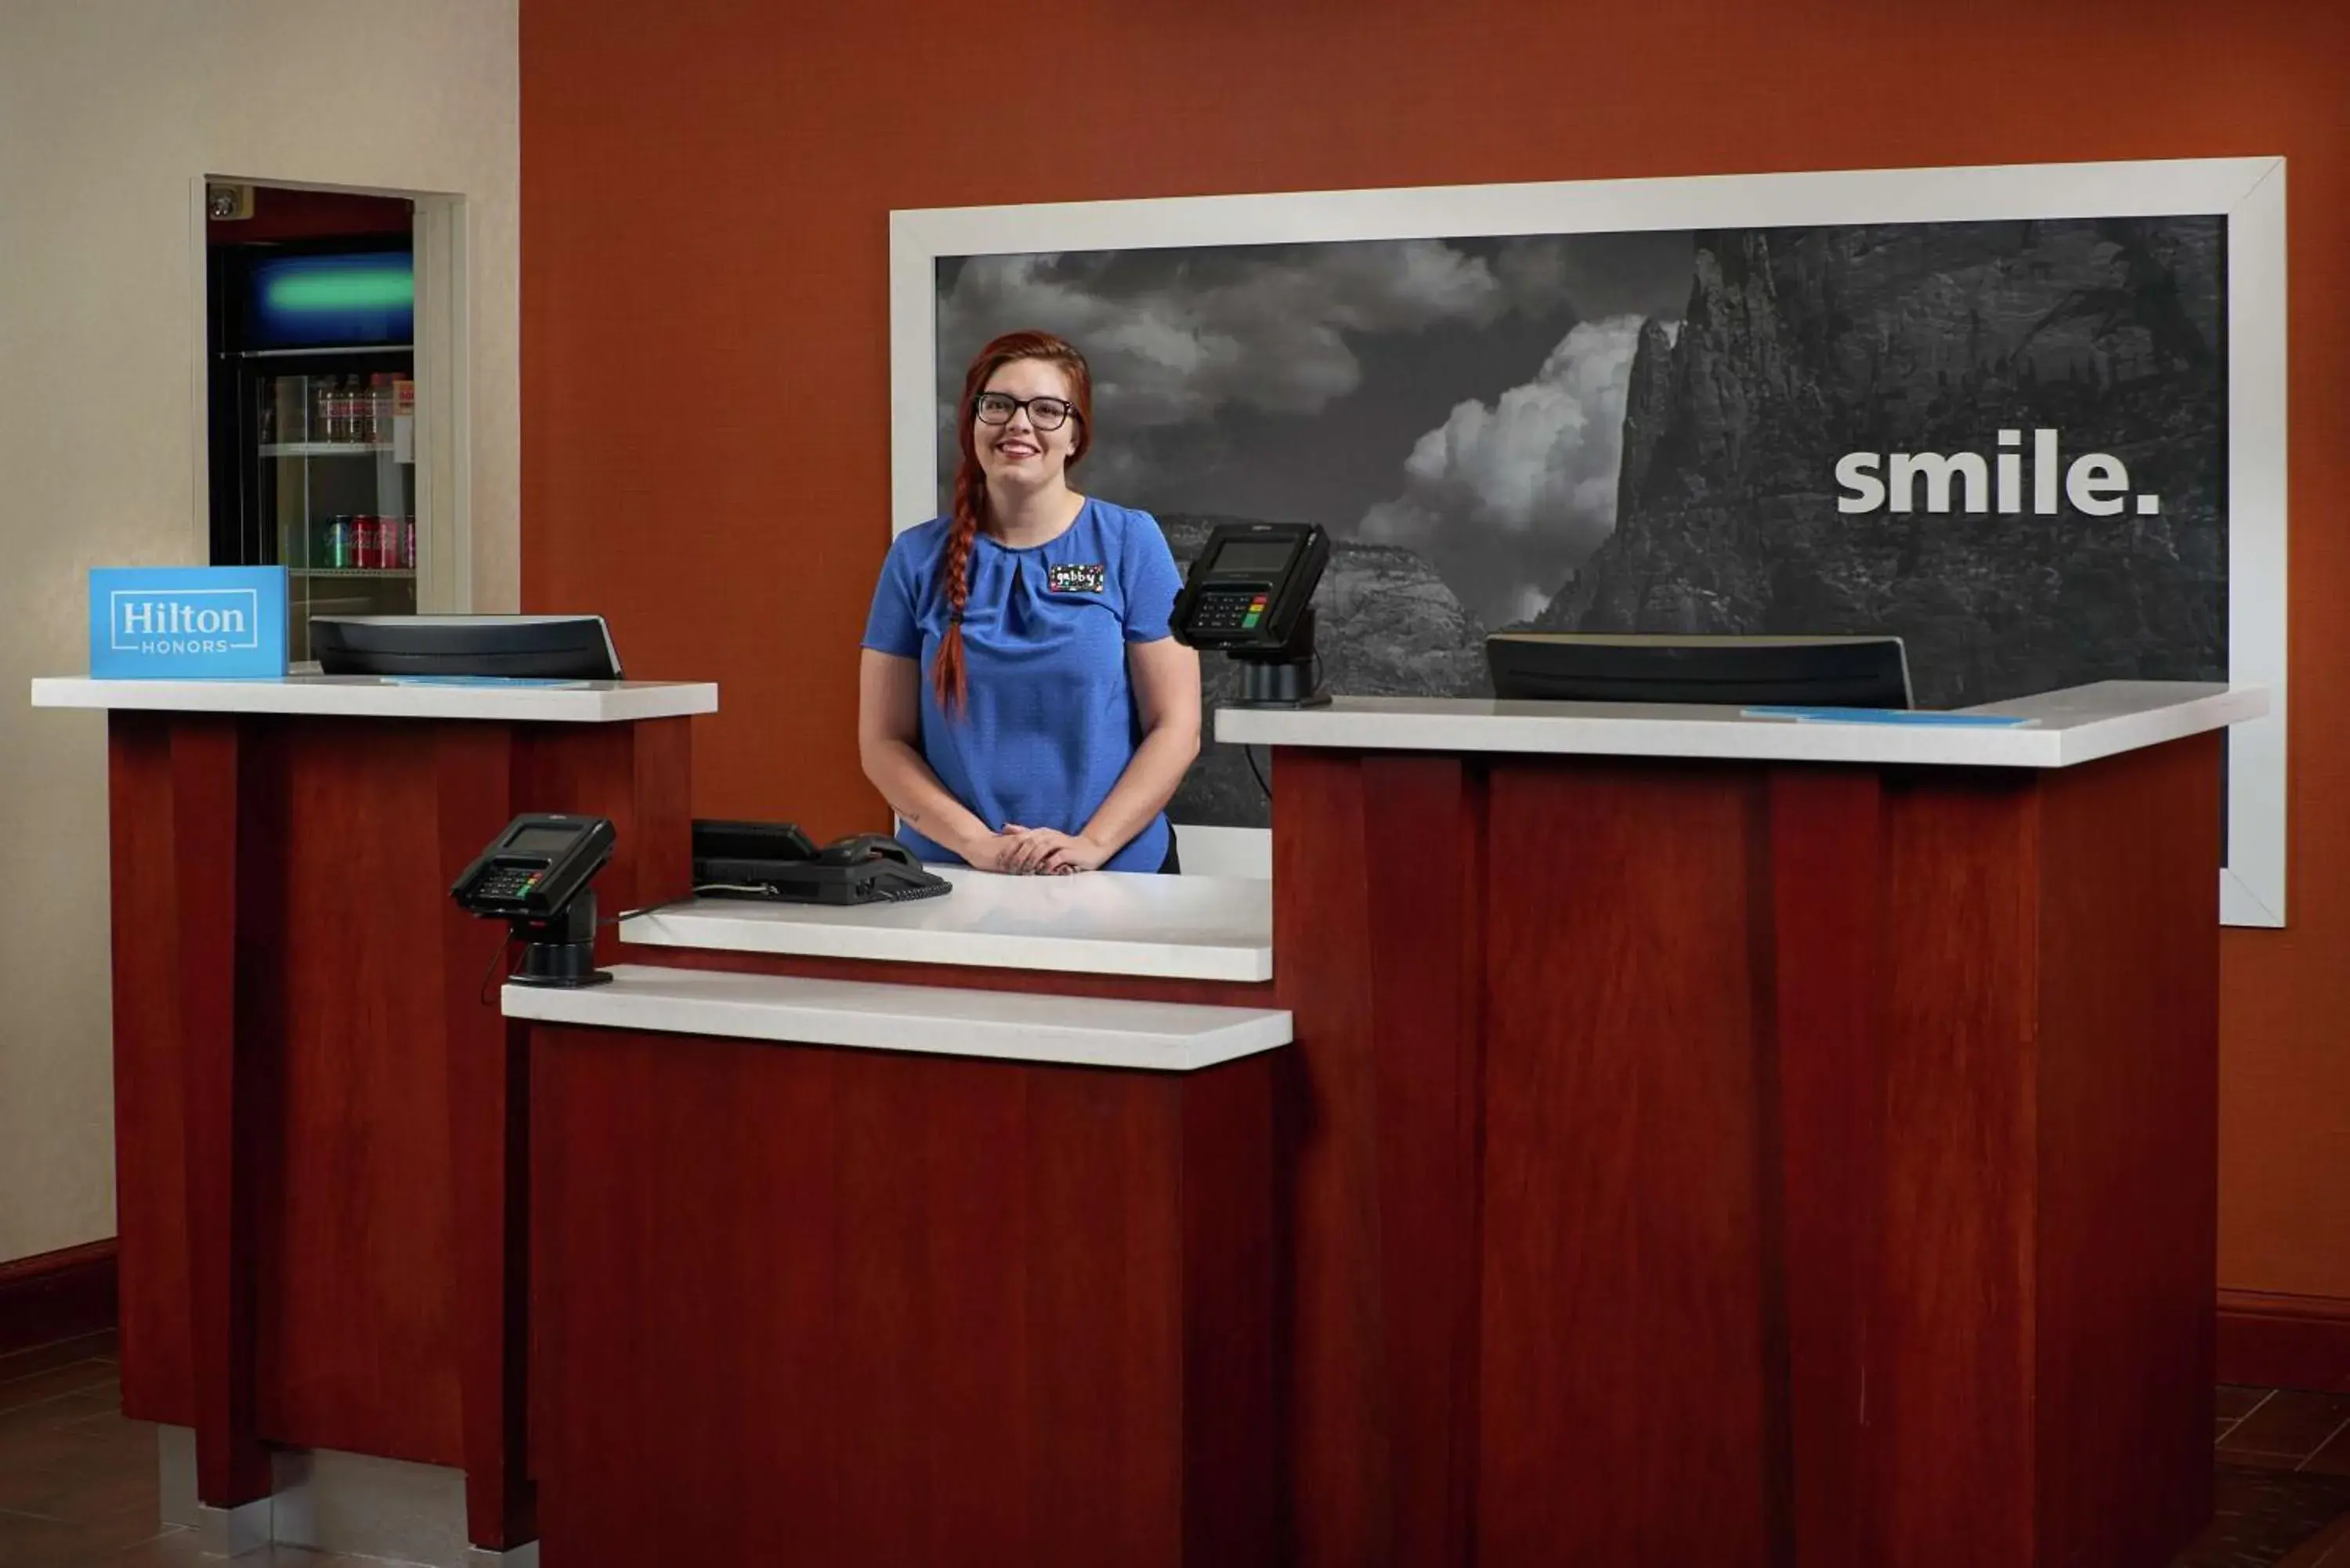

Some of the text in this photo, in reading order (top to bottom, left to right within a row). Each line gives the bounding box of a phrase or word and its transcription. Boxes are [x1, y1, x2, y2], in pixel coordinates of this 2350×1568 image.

[1834, 428, 2160, 517] smile.
[1057, 570, 1095, 587] gabby
[123, 602, 246, 634] Hilton
[142, 640, 228, 655] HONORS
